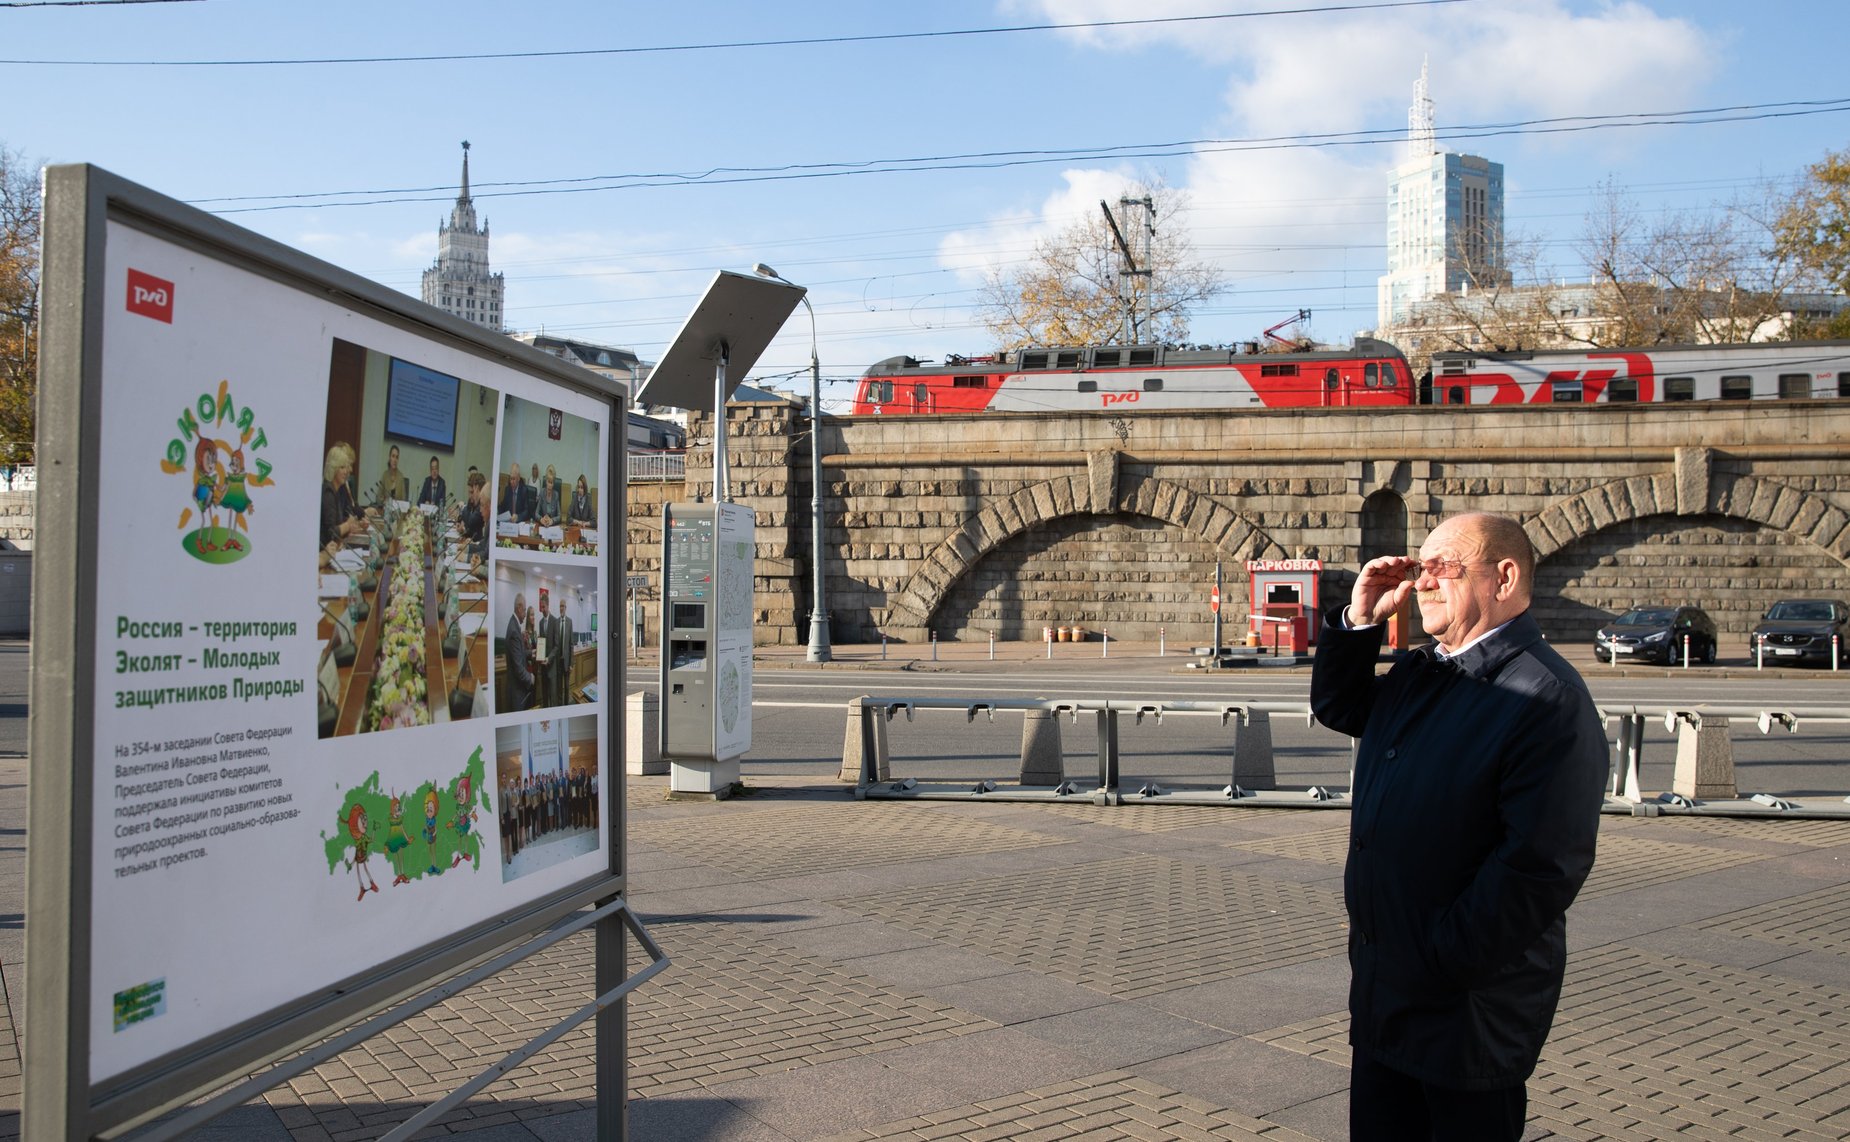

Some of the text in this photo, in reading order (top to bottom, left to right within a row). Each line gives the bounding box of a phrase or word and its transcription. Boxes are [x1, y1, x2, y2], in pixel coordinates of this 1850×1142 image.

[167, 393, 273, 483] ЭКОЛЯТА
[1246, 560, 1320, 571] ПАРКОВКА
[627, 577, 646, 587] СТОП
[116, 616, 183, 639] Россия
[204, 621, 297, 642] территория
[115, 650, 182, 674] Эколят
[203, 648, 280, 670] Молодых
[115, 677, 304, 709] защитников Природы
[115, 726, 293, 758] На 354-м заседании Совета Федерации
[115, 745, 270, 778] Валентина Ивановна Матвиенко,
[115, 762, 271, 799] Председатель Совета Федерации,
[114, 777, 283, 818] поддержала инициативы комитетов
[114, 793, 293, 839] Совета Федерации по развитию новых
[114, 808, 301, 860] природоохранных социально-образова-
[114, 847, 208, 878] тельных проектов.
